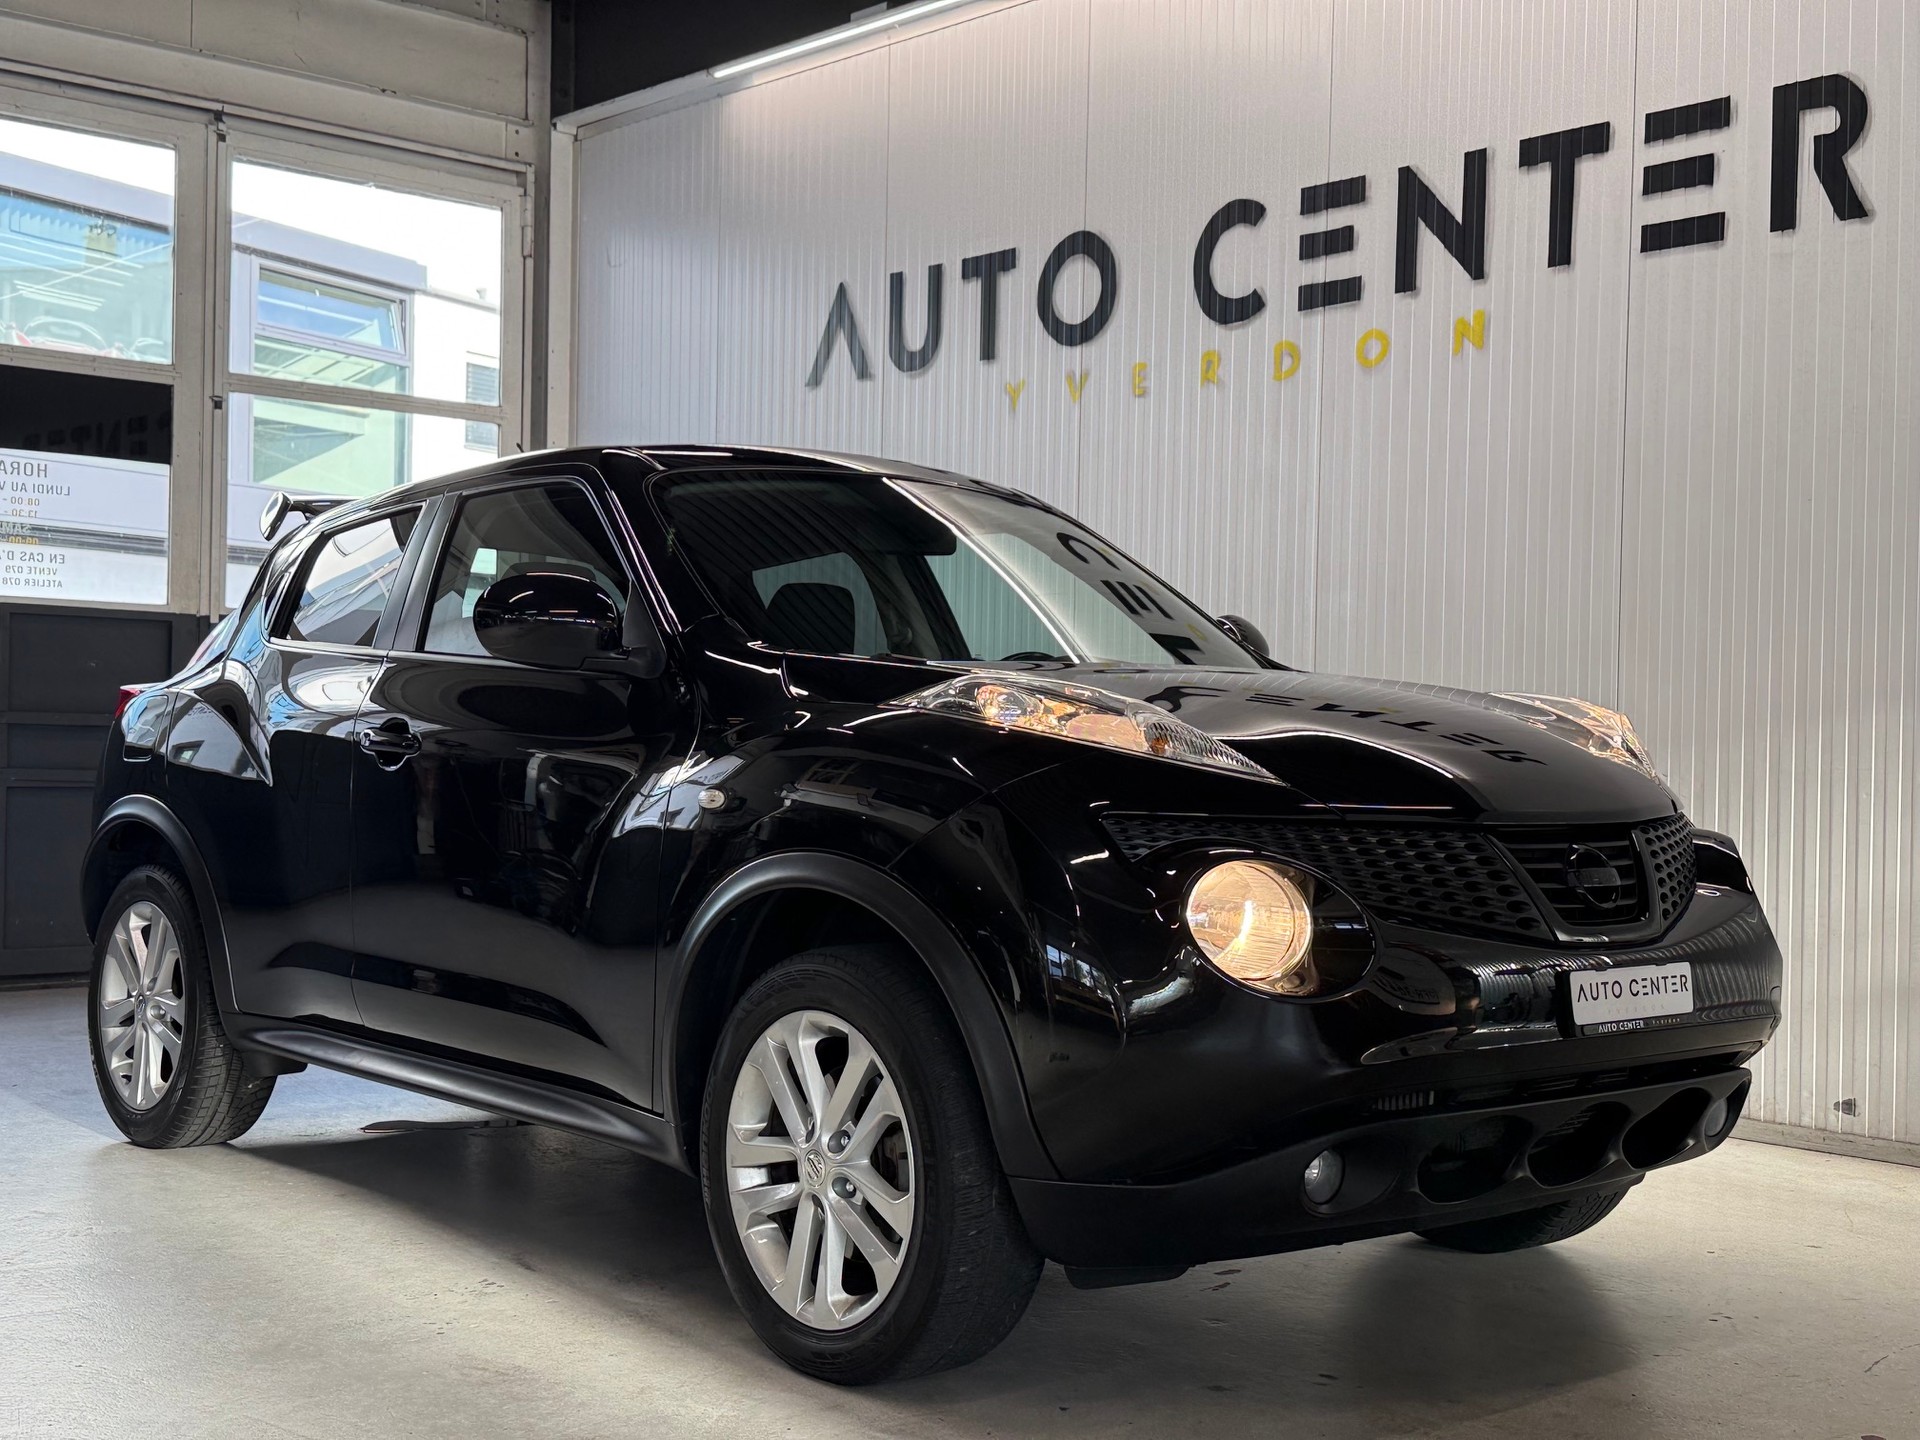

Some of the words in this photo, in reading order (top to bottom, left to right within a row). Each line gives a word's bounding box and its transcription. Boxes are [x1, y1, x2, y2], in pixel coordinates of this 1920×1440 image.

[804, 230, 1118, 387] AUTO
[1193, 73, 1870, 325] CENTER
[1005, 309, 1486, 411] YVERDON
[1577, 980, 1623, 1002] AUTO
[1629, 974, 1689, 996] CENTER
[1598, 1021, 1617, 1033] AUTO
[1619, 1019, 1645, 1031] CENTER
